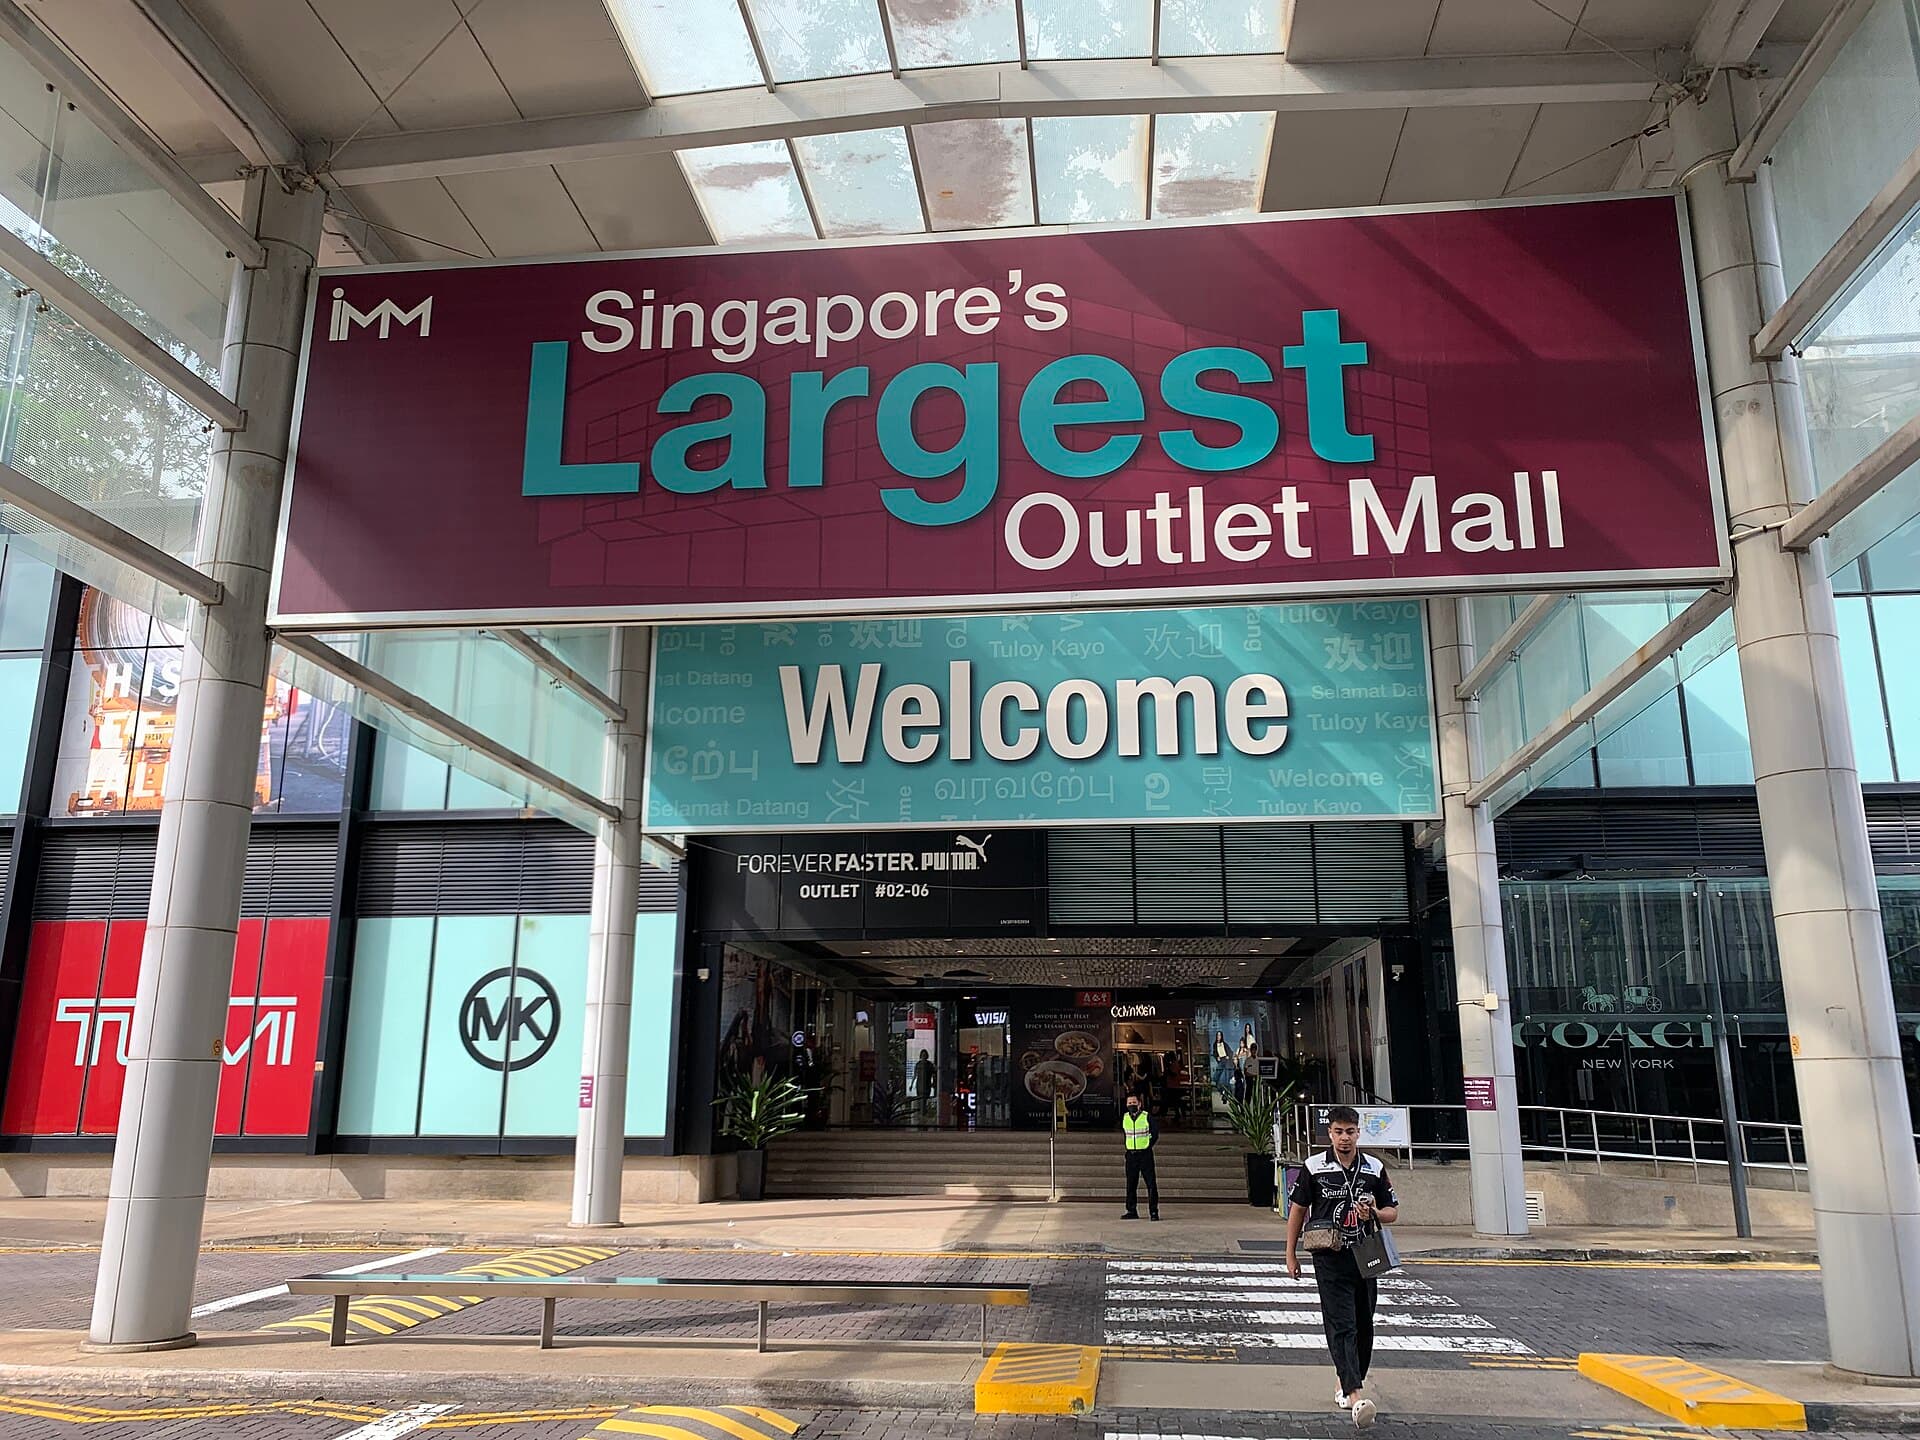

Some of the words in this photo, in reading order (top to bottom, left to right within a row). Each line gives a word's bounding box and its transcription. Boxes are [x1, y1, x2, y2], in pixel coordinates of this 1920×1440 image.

[580, 269, 1069, 363] Singapore's
[521, 308, 1376, 527] Largest
[1004, 486, 1313, 570] Outlet
[1348, 470, 1565, 556] Mall
[989, 640, 1044, 661] Tuloy
[1051, 638, 1105, 659] Kayo
[1143, 623, 1225, 661] 欢迎
[1323, 633, 1414, 672] 欢迎
[688, 671, 752, 688] Datang
[1311, 684, 1385, 700] Selamat
[654, 703, 746, 725] lcome
[778, 659, 1289, 764] Welcome
[1307, 713, 1368, 734] Tuloy
[1270, 768, 1384, 788] Welcome
[649, 801, 733, 818] Selamat
[737, 799, 809, 819] Datang
[799, 884, 860, 899] OUTLET
[875, 884, 930, 898] #02-06
[470, 996, 551, 1042] MK
[1582, 1059, 1621, 1069] NEW
[1630, 1059, 1675, 1069] YORK
